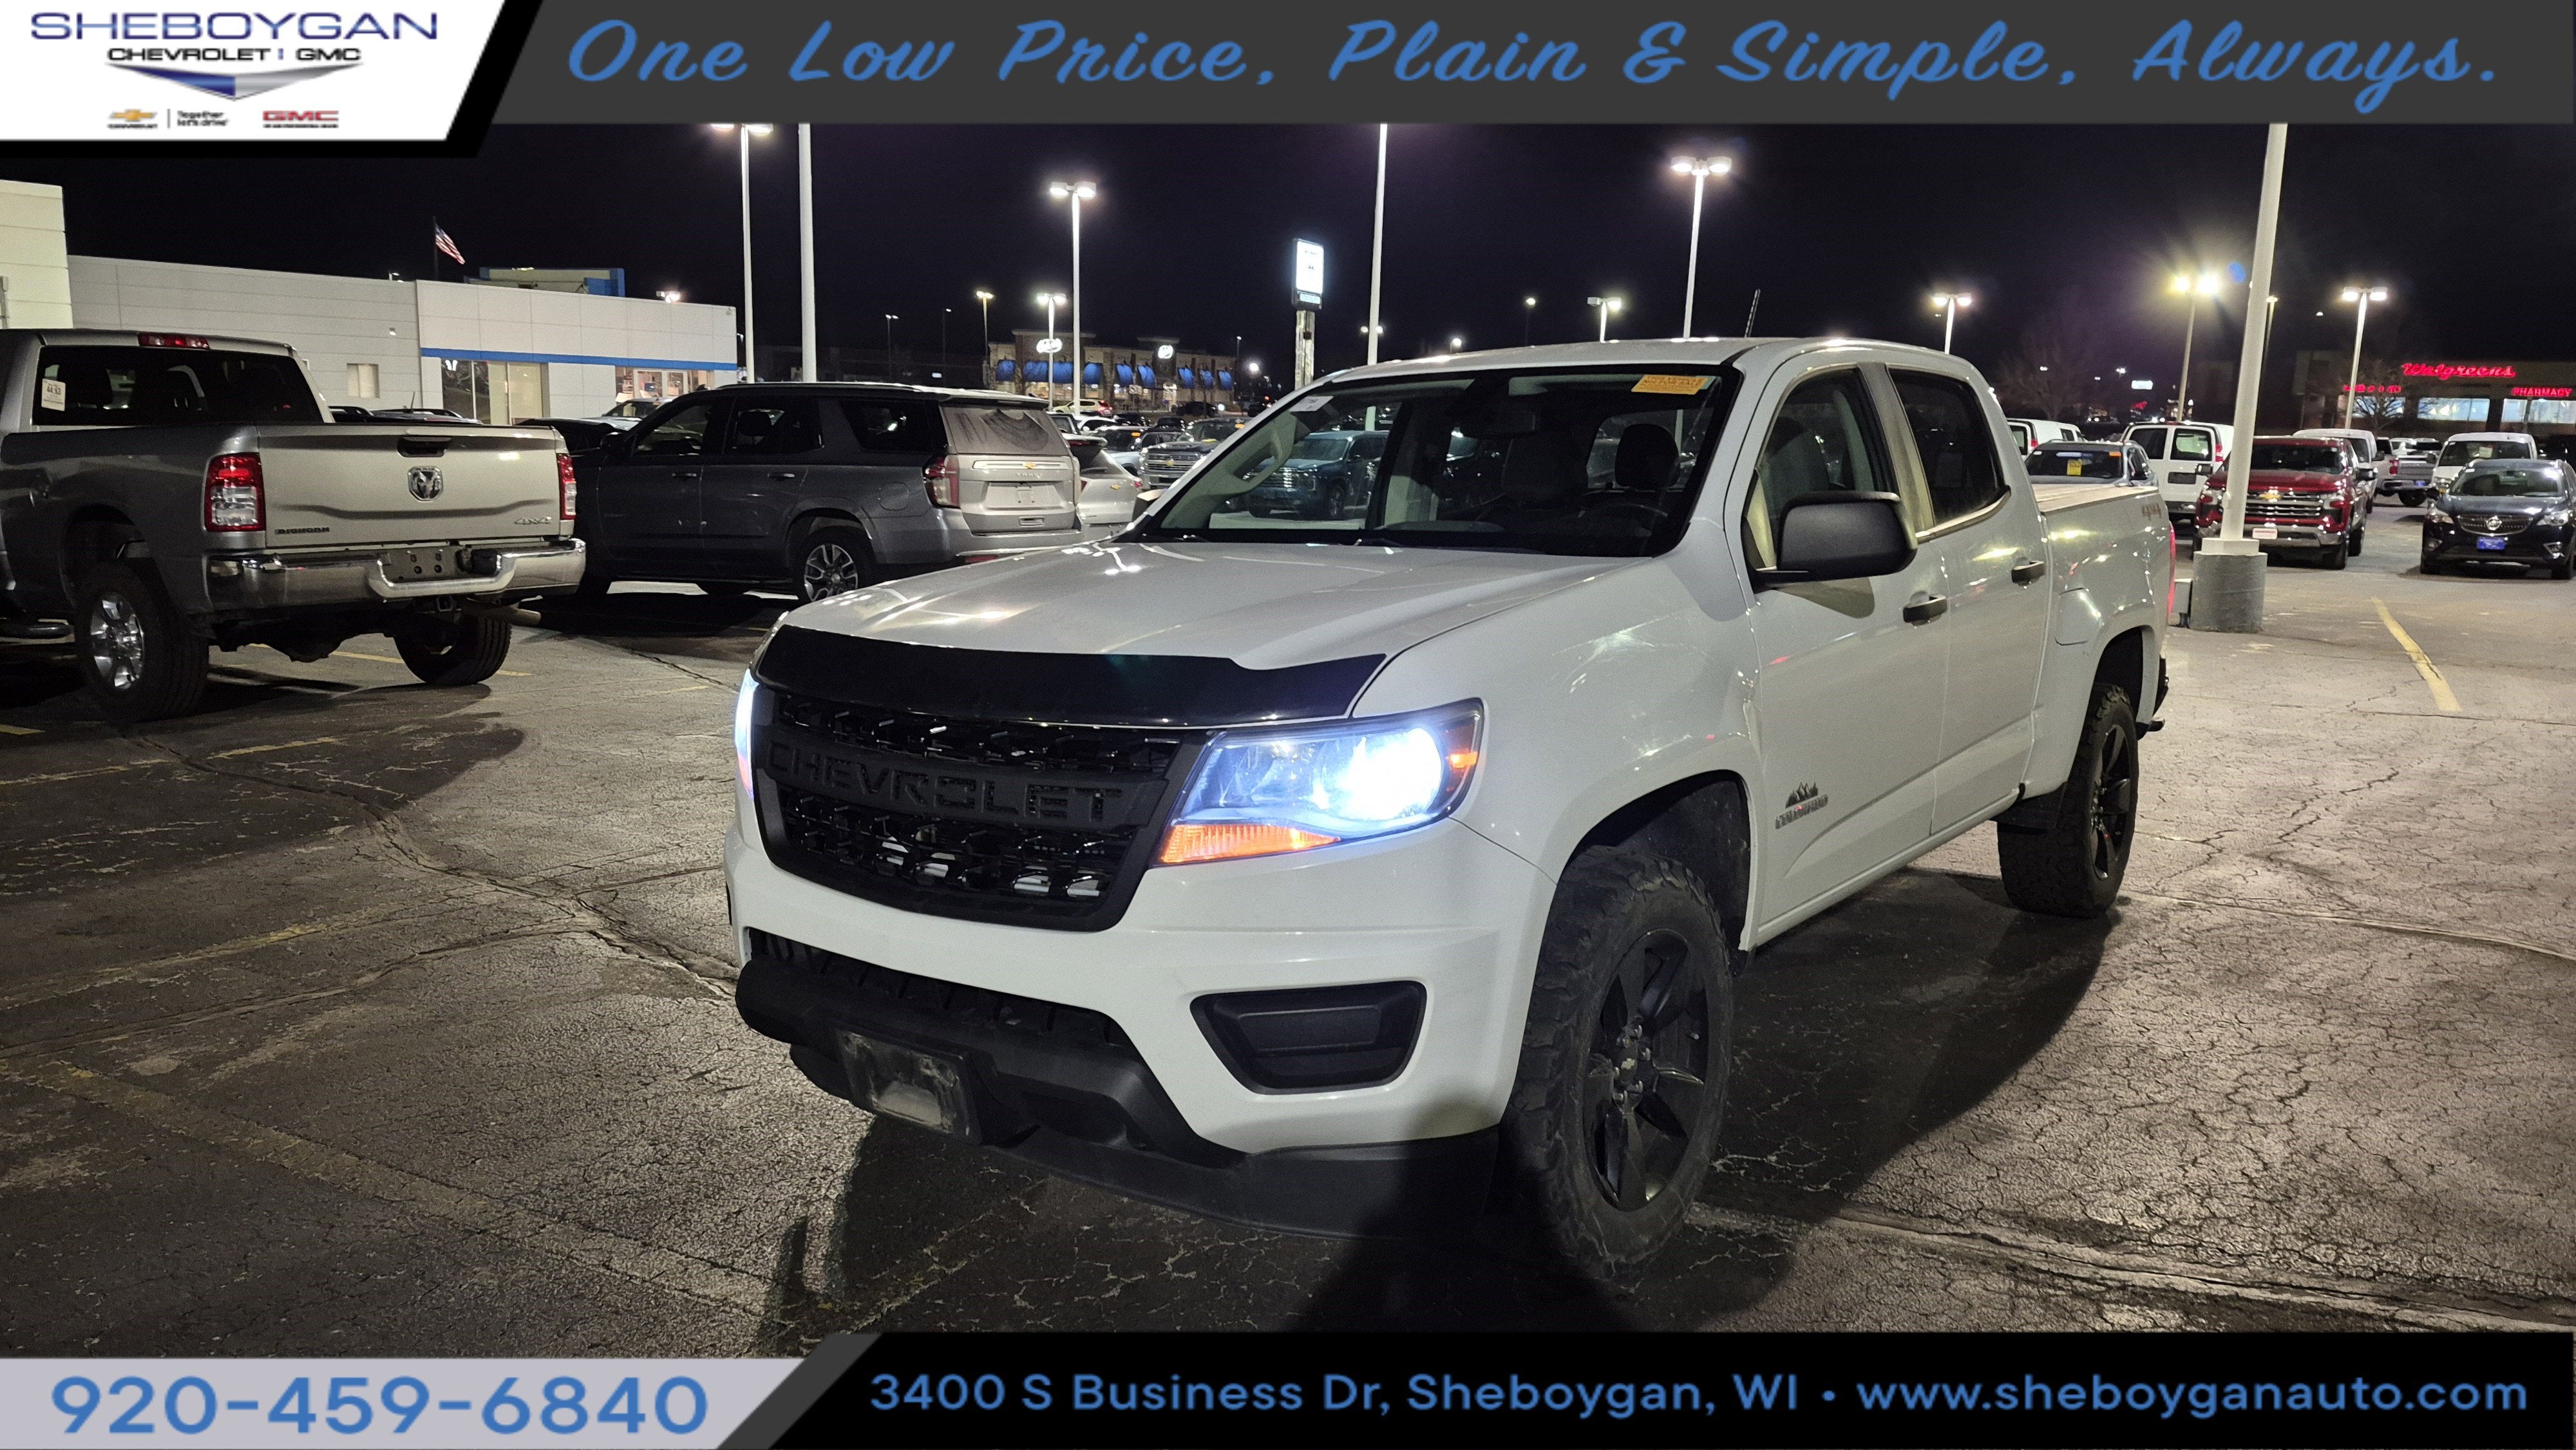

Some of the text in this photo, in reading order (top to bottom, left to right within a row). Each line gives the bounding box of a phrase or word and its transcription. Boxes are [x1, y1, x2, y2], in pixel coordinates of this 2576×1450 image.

[2400, 362, 2517, 381] Walgreens
[2512, 387, 2572, 397] PHARMACY
[766, 740, 1123, 823] CHEVROLET
